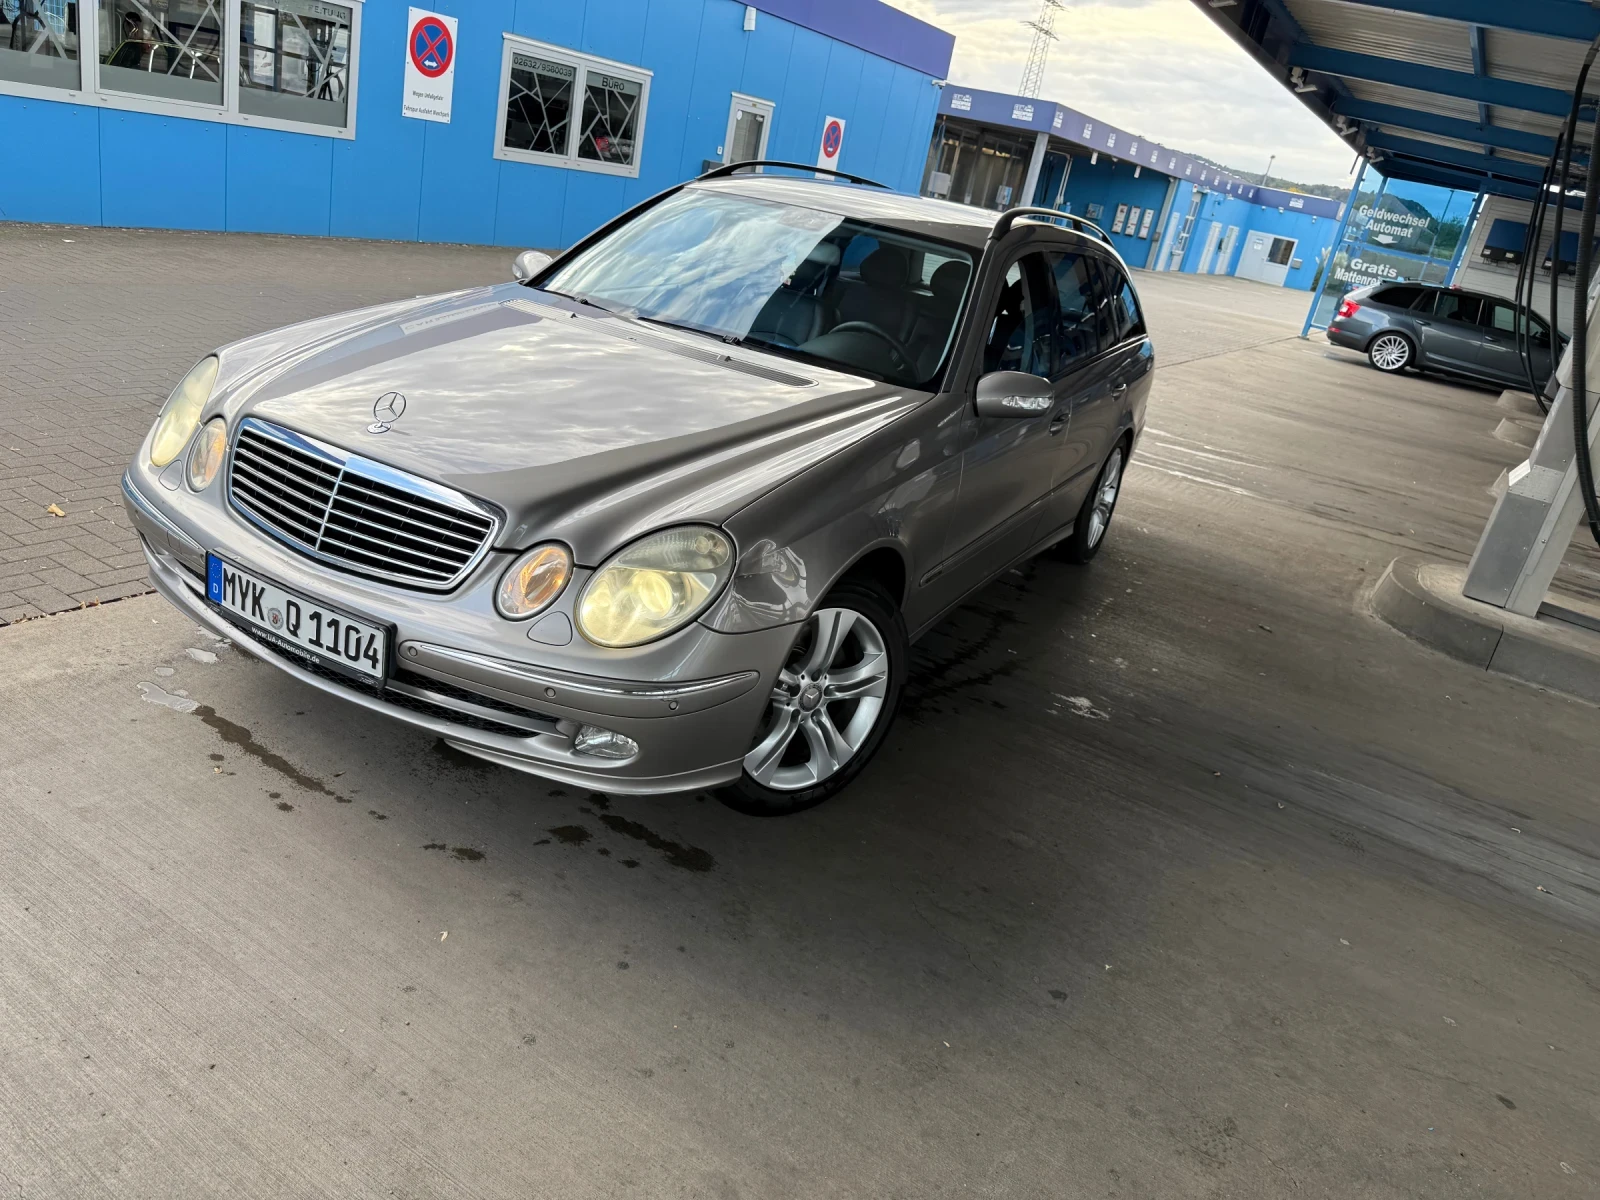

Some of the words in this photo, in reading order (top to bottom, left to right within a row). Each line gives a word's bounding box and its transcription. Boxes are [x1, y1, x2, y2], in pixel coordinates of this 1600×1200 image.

[513, 56, 572, 77] 02632/9580039
[601, 76, 625, 91] BÜRO
[1359, 205, 1430, 228] Geldwechsel
[1365, 219, 1414, 238] Automat
[1334, 268, 1382, 286] Mattenrei
[1350, 258, 1398, 278] Gratis
[223, 567, 266, 622] MYK
[286, 599, 301, 639] Q
[308, 610, 379, 670] 1104
[251, 626, 320, 664] www.UA-Automobile.de
